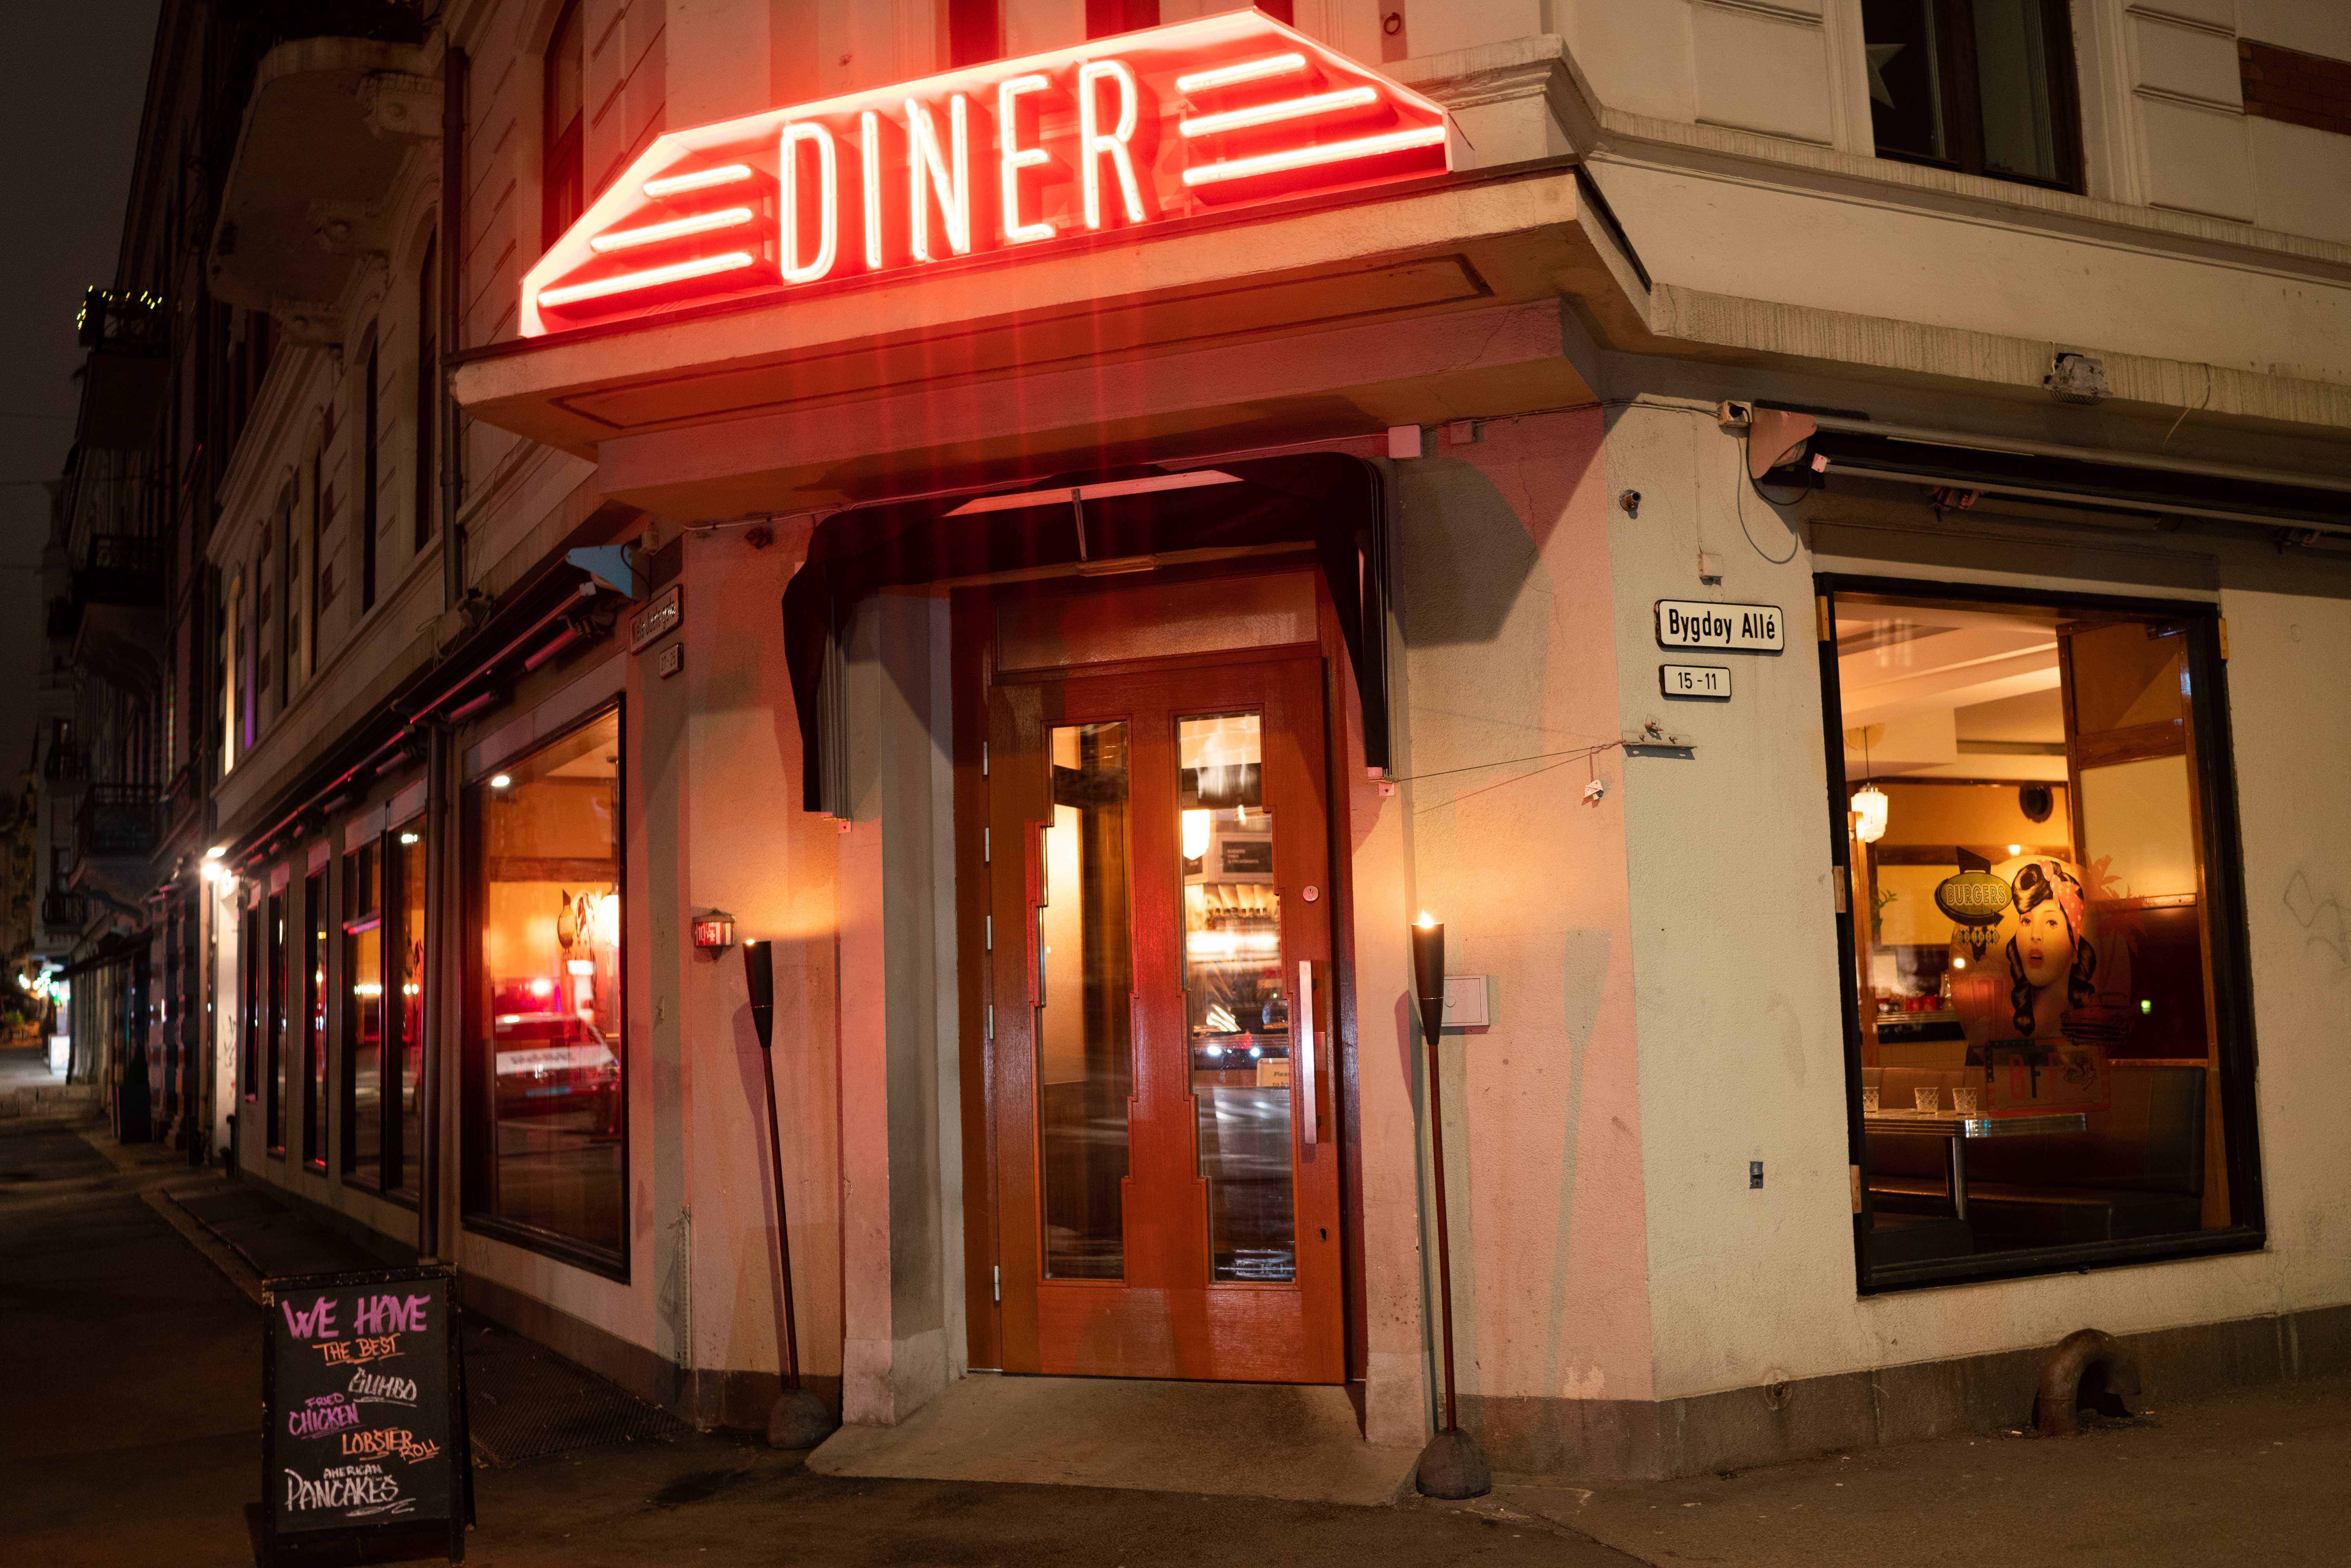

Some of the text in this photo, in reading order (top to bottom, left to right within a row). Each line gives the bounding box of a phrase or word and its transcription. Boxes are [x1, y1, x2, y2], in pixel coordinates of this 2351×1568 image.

[780, 60, 1146, 284] DINER
[1668, 608, 1775, 644] Bygdøy Allé
[1946, 884, 2006, 905] BURGERS
[282, 1294, 431, 1340] WE HAVE
[312, 1333, 401, 1362] THE BEST
[348, 1367, 418, 1401] GUMBO
[304, 1392, 345, 1408] FRIED
[288, 1403, 360, 1437] CHICKEN
[342, 1427, 413, 1455] LOBSTER
[399, 1439, 441, 1461] ROLL
[323, 1464, 384, 1479] AMERICAN
[284, 1468, 398, 1511] PANCAKES
